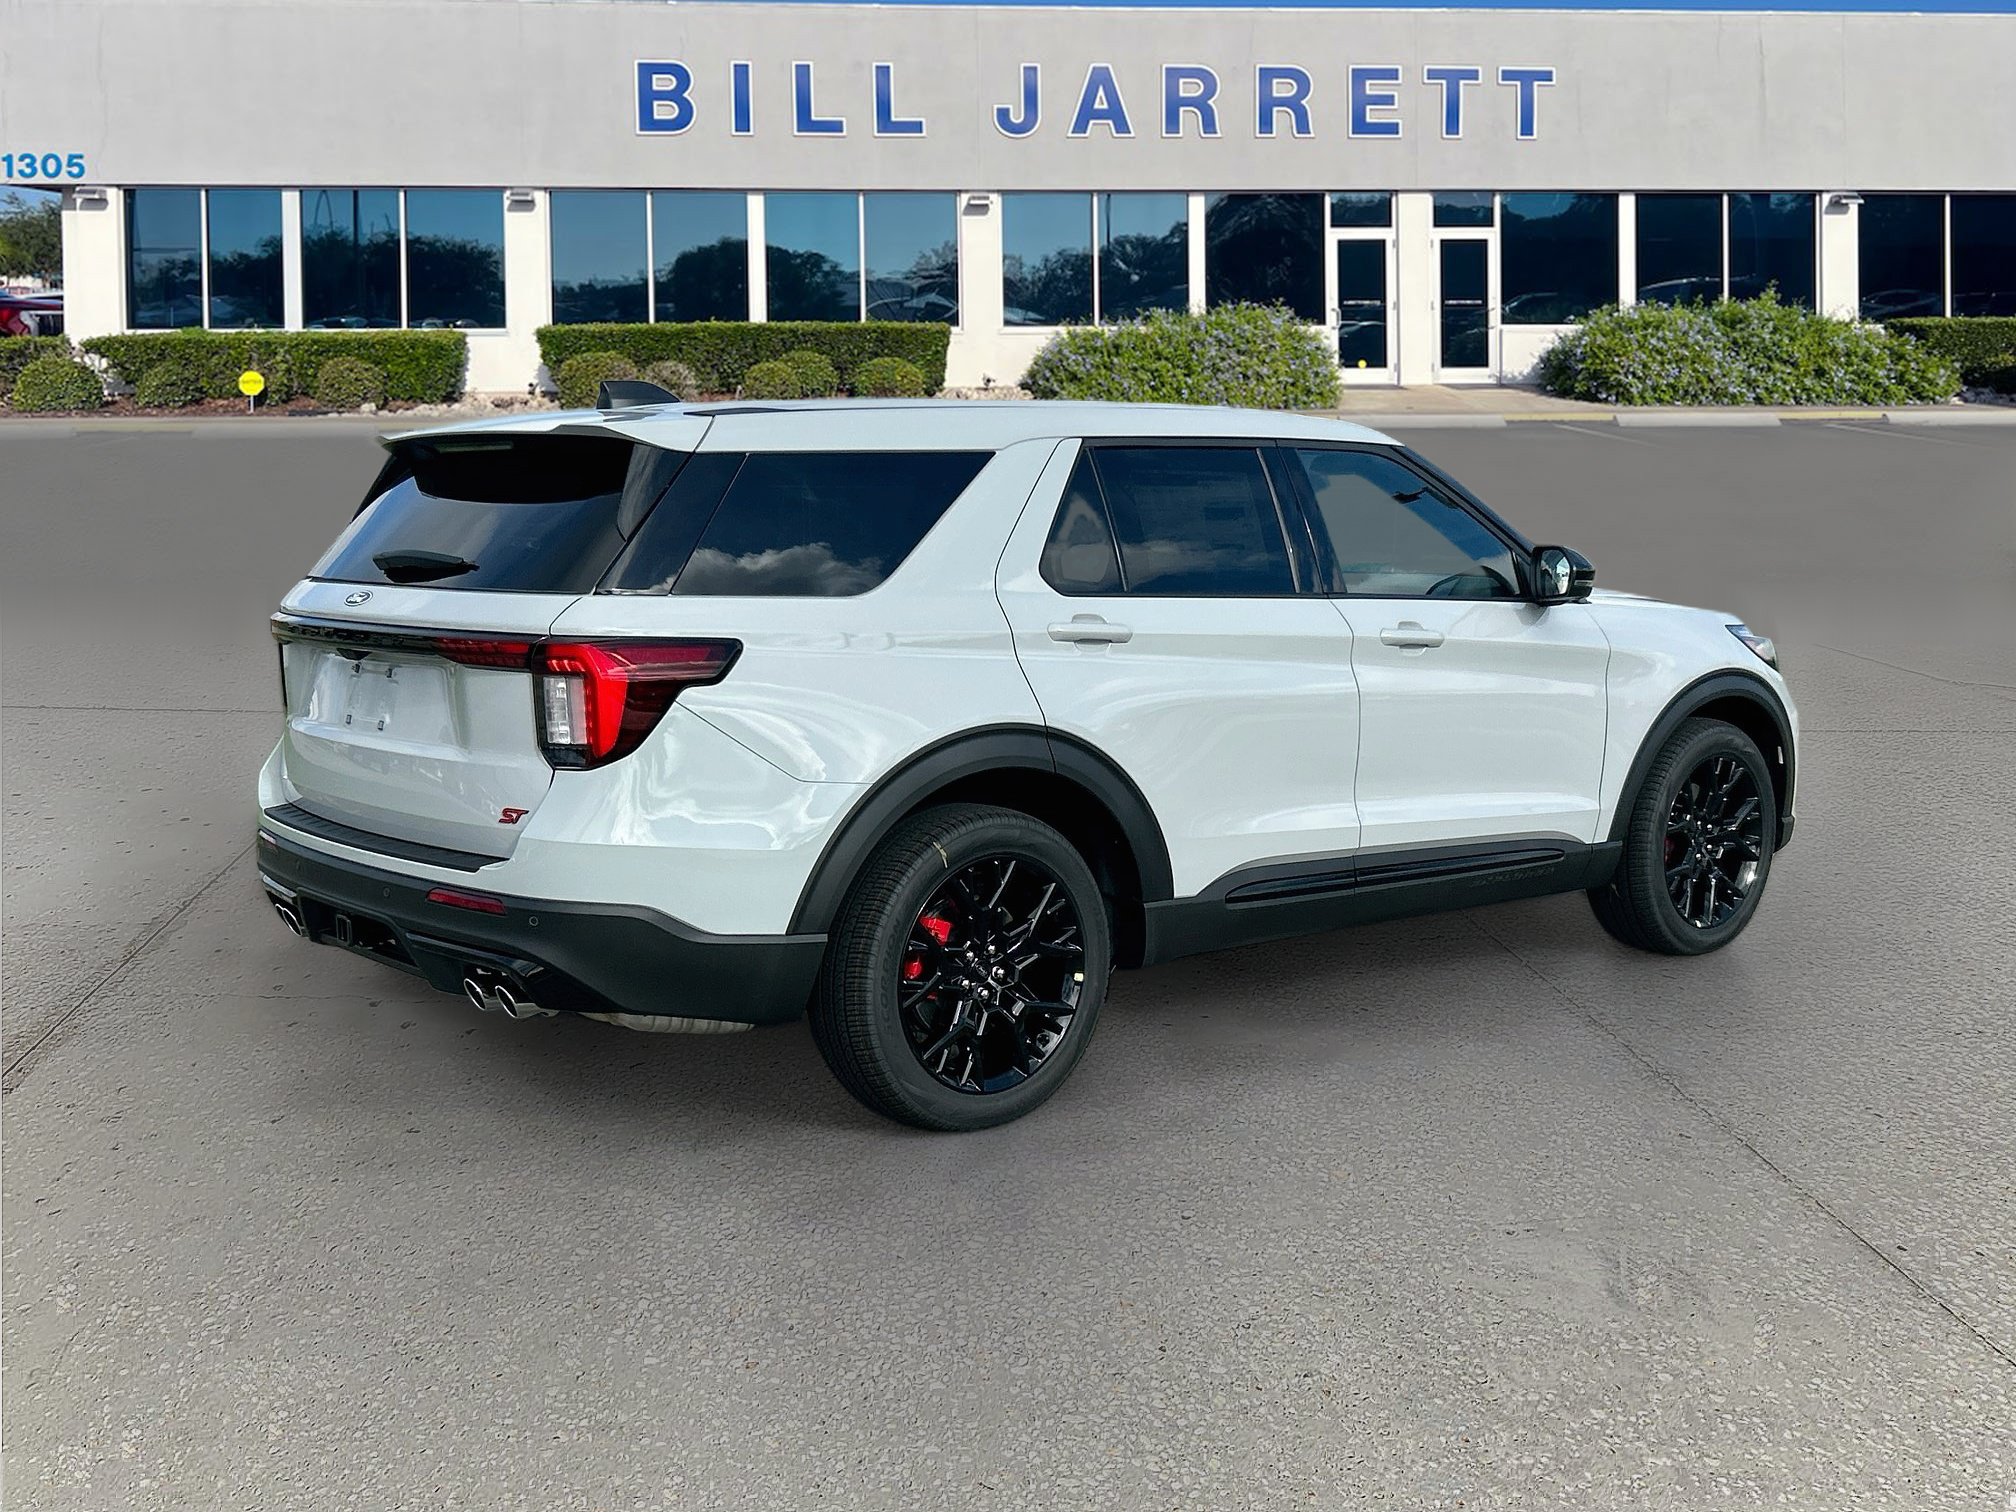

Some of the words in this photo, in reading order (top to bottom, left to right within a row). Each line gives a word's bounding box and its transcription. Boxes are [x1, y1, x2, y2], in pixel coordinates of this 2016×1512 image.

[635, 59, 926, 136] BILL
[994, 62, 1556, 139] JARRETT
[1, 152, 86, 179] 1305
[498, 807, 530, 825] ST
